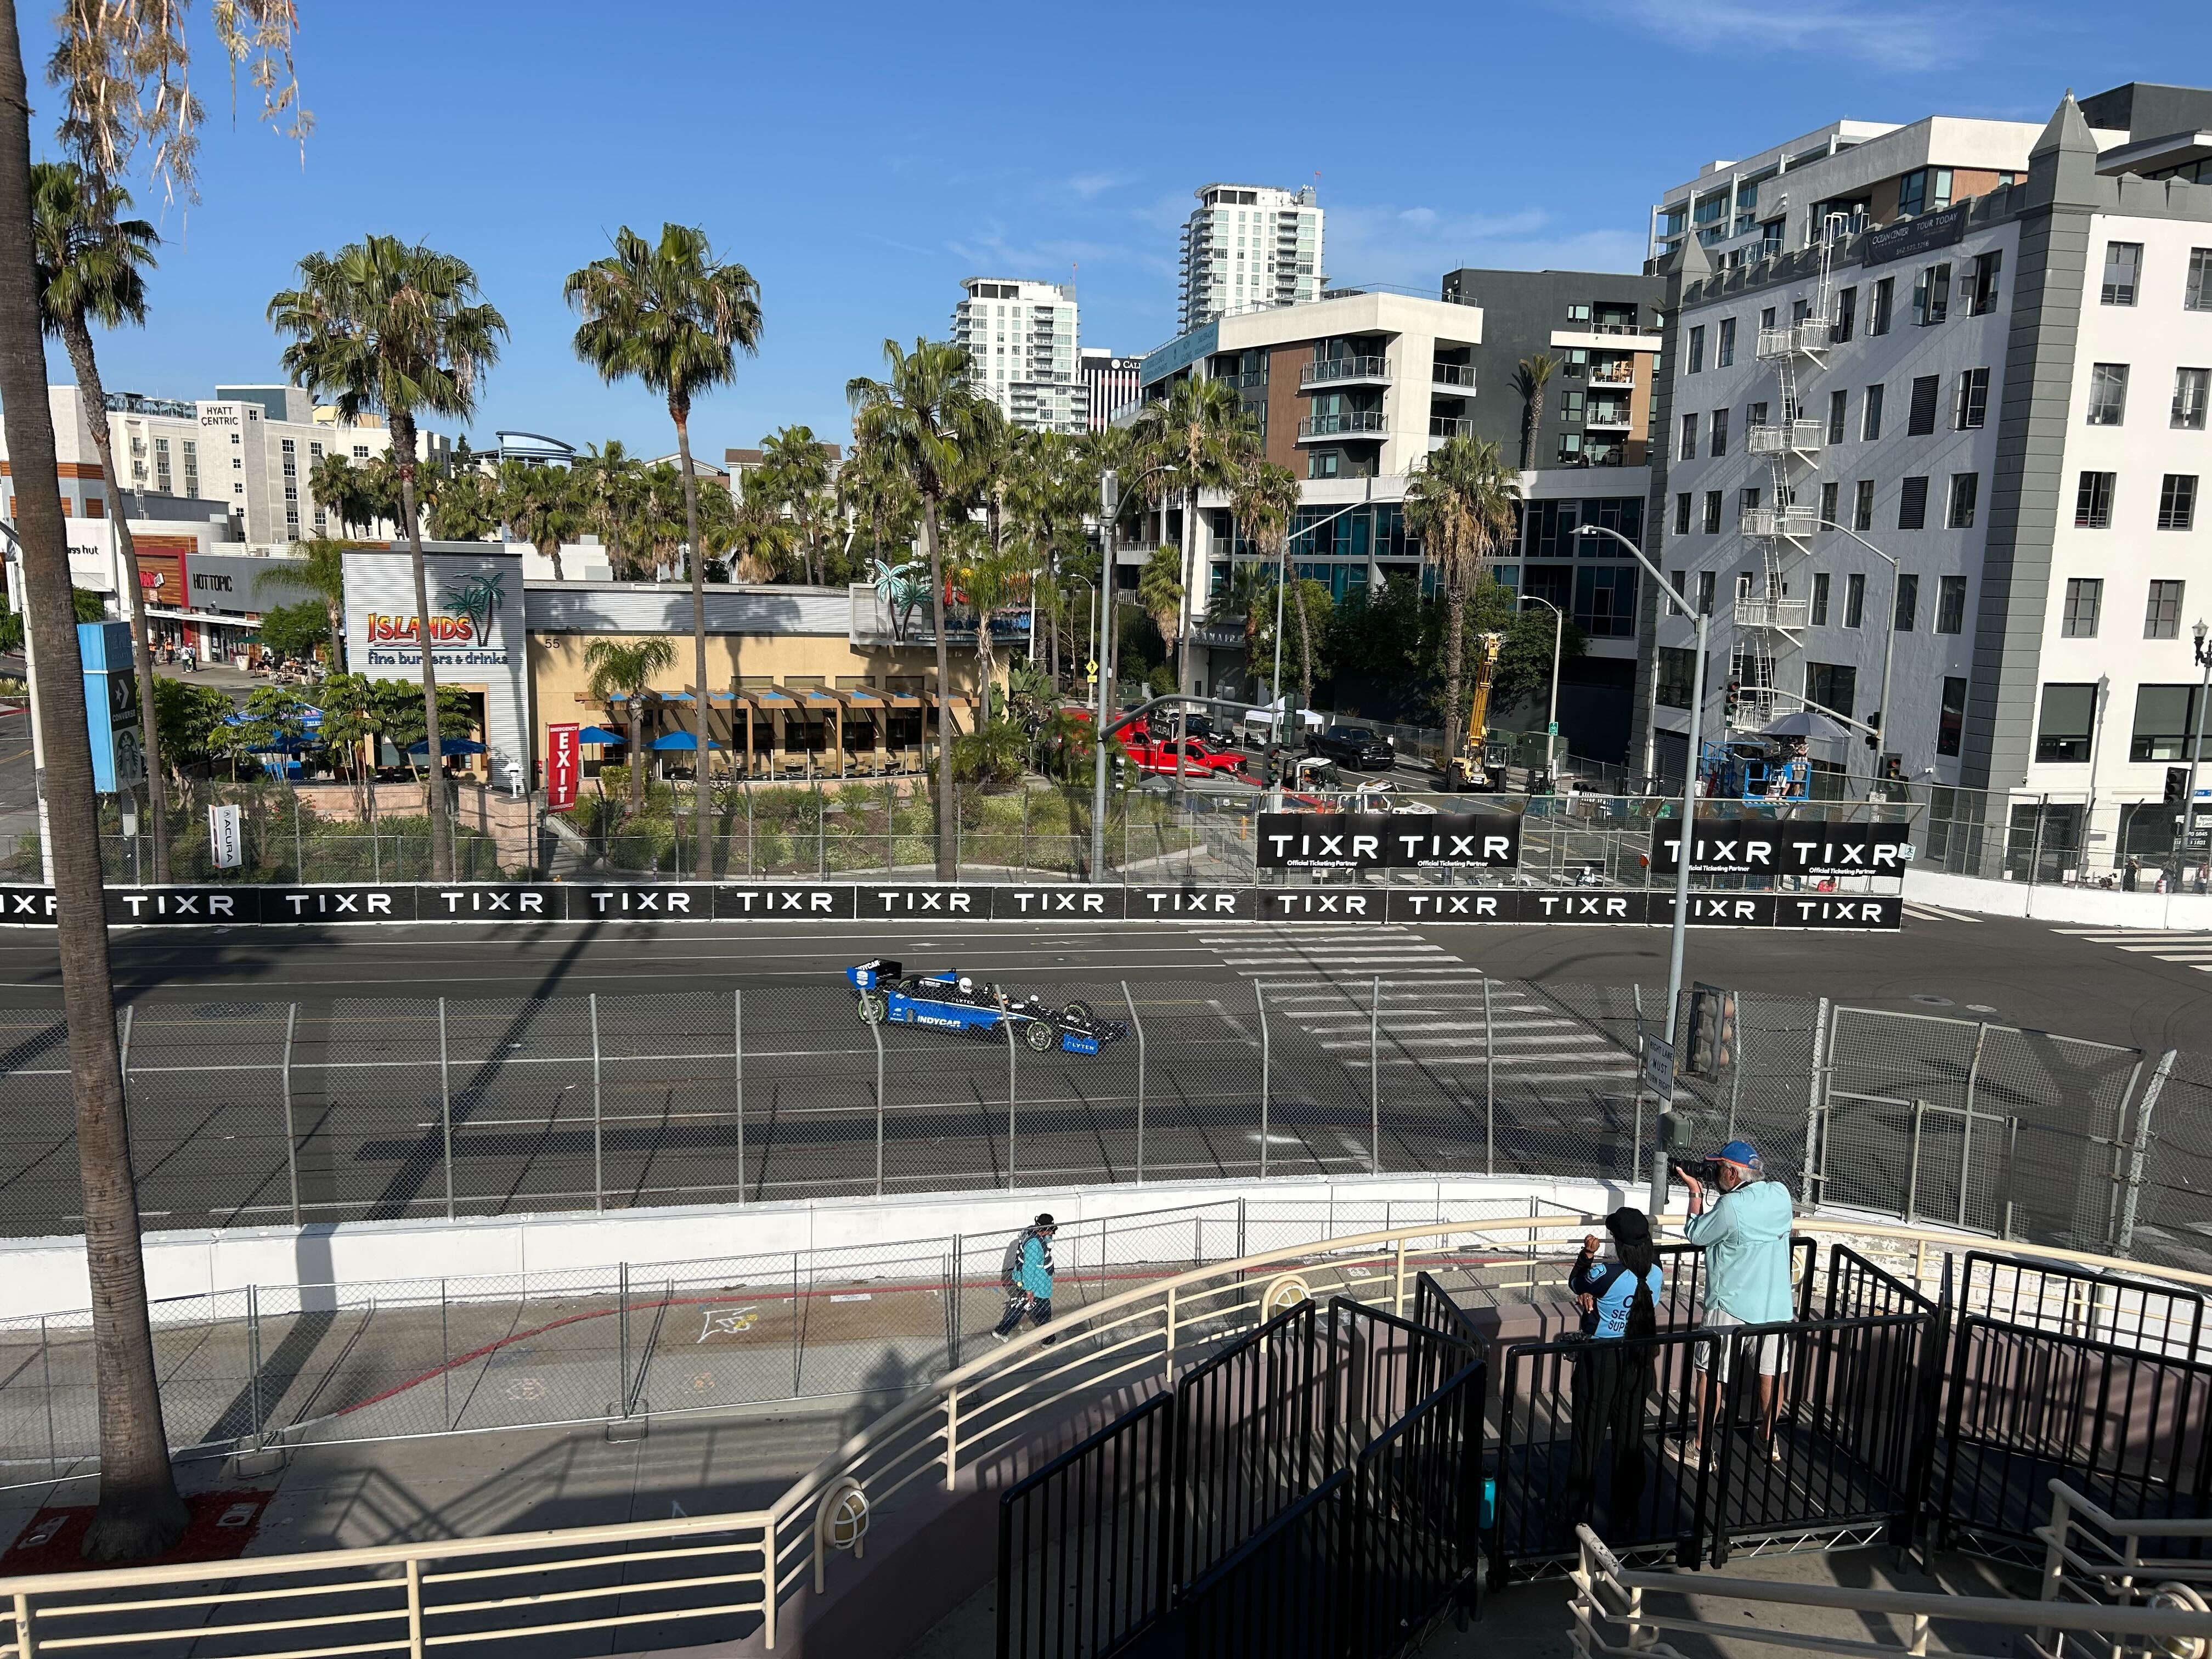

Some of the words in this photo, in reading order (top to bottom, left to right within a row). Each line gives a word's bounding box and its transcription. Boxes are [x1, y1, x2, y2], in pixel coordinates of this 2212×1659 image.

[1917, 219, 1933, 231] TOUR
[1936, 212, 1958, 225] TODAY
[1872, 234, 1891, 245] OCEAN
[1891, 227, 1909, 239] CENTER
[207, 407, 233, 415] HYATT
[201, 417, 238, 426] CENTRIC
[82, 544, 99, 555] hut
[193, 573, 208, 590] HOT
[209, 574, 233, 592] TOPIC
[545, 639, 560, 648] 55
[368, 651, 395, 664] fine
[398, 651, 452, 664] burers
[465, 652, 508, 665] drinks
[112, 709, 136, 723] CONVERSE
[1154, 724, 1171, 737] ACURA
[556, 732, 571, 803] EXIT
[224, 819, 233, 863] ACURA
[1269, 835, 1379, 859] TIXR
[1399, 836, 1509, 860] TIXR
[1664, 840, 1771, 865] TIXR
[1792, 842, 1898, 867] TIXR
[123, 895, 234, 916] TIXR
[285, 894, 392, 915] TIXR
[441, 893, 543, 913] TIXR
[591, 893, 690, 913] TIXR
[736, 892, 833, 912] TIXR
[878, 893, 970, 913] TIXR
[1014, 893, 1104, 913] TIXR
[1147, 894, 1236, 913] TIXR
[1277, 895, 1366, 915] TIXR
[1408, 896, 1497, 916] TIXR
[1539, 897, 1627, 917] TIXR
[1797, 902, 1882, 923] TIXR
[917, 1015, 961, 1028] INDYCAR
[1072, 1042, 1094, 1051] LYTEN
[1650, 1041, 1662, 1053] RIGHT
[1662, 1048, 1673, 1062] LANE
[1652, 1058, 1667, 1075] MUST
[1647, 1071, 1657, 1085] TURN
[1658, 1079, 1671, 1093] RIGHT
